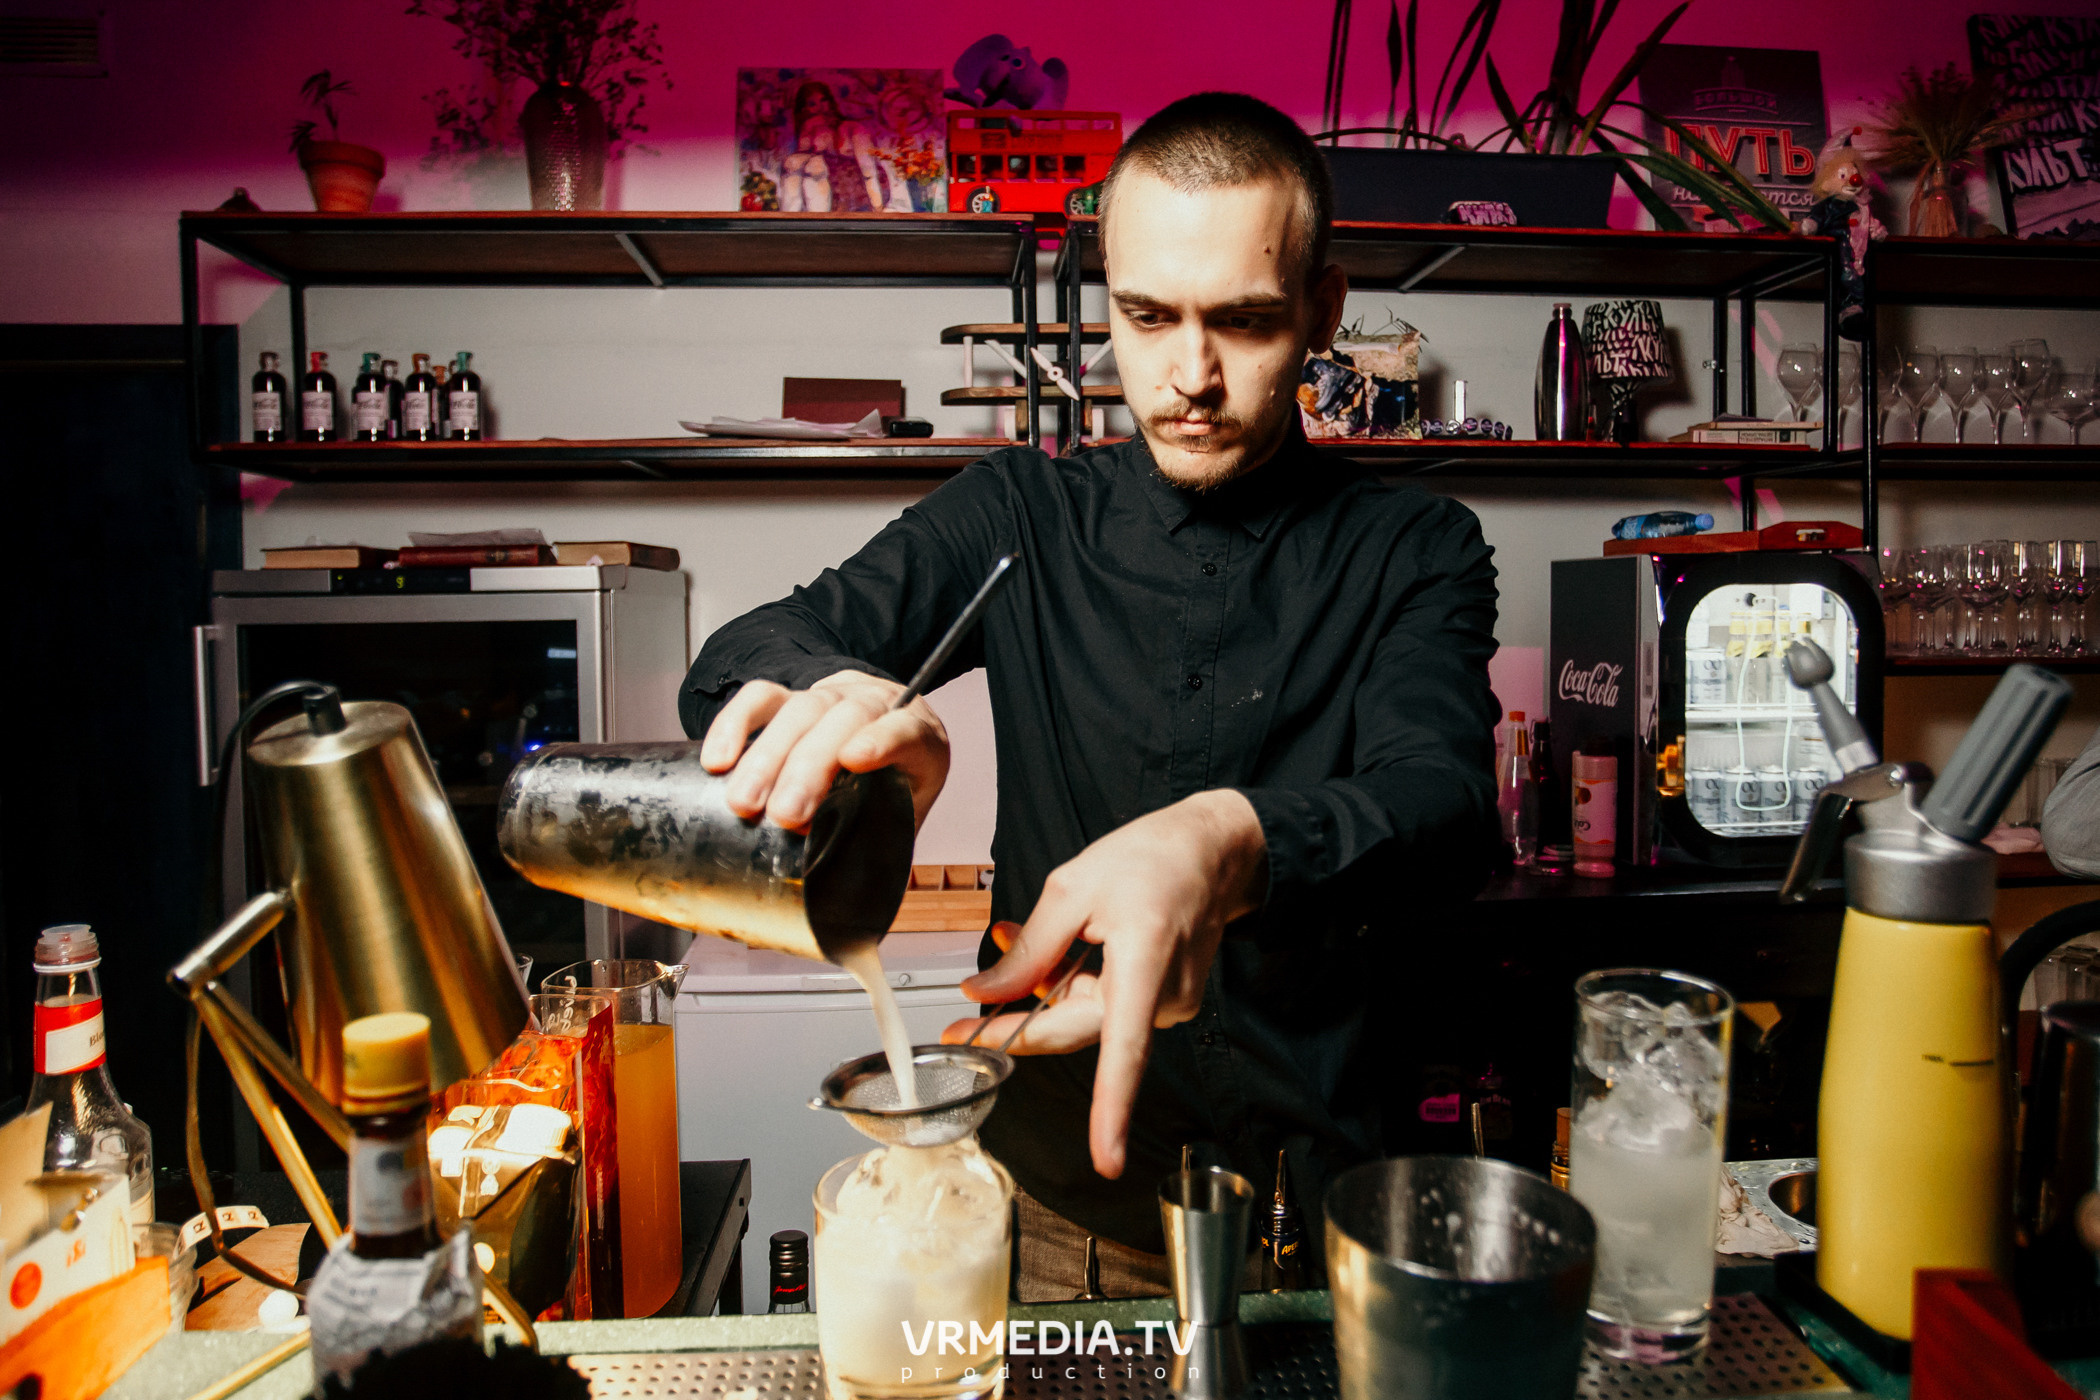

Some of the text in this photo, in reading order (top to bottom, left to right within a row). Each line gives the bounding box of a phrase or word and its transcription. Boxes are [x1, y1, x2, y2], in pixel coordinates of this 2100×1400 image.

[1665, 123, 1815, 177] ПУТЬ
[2002, 137, 2090, 195] КУЛЬТ
[1558, 659, 1623, 707] Coca-Cola
